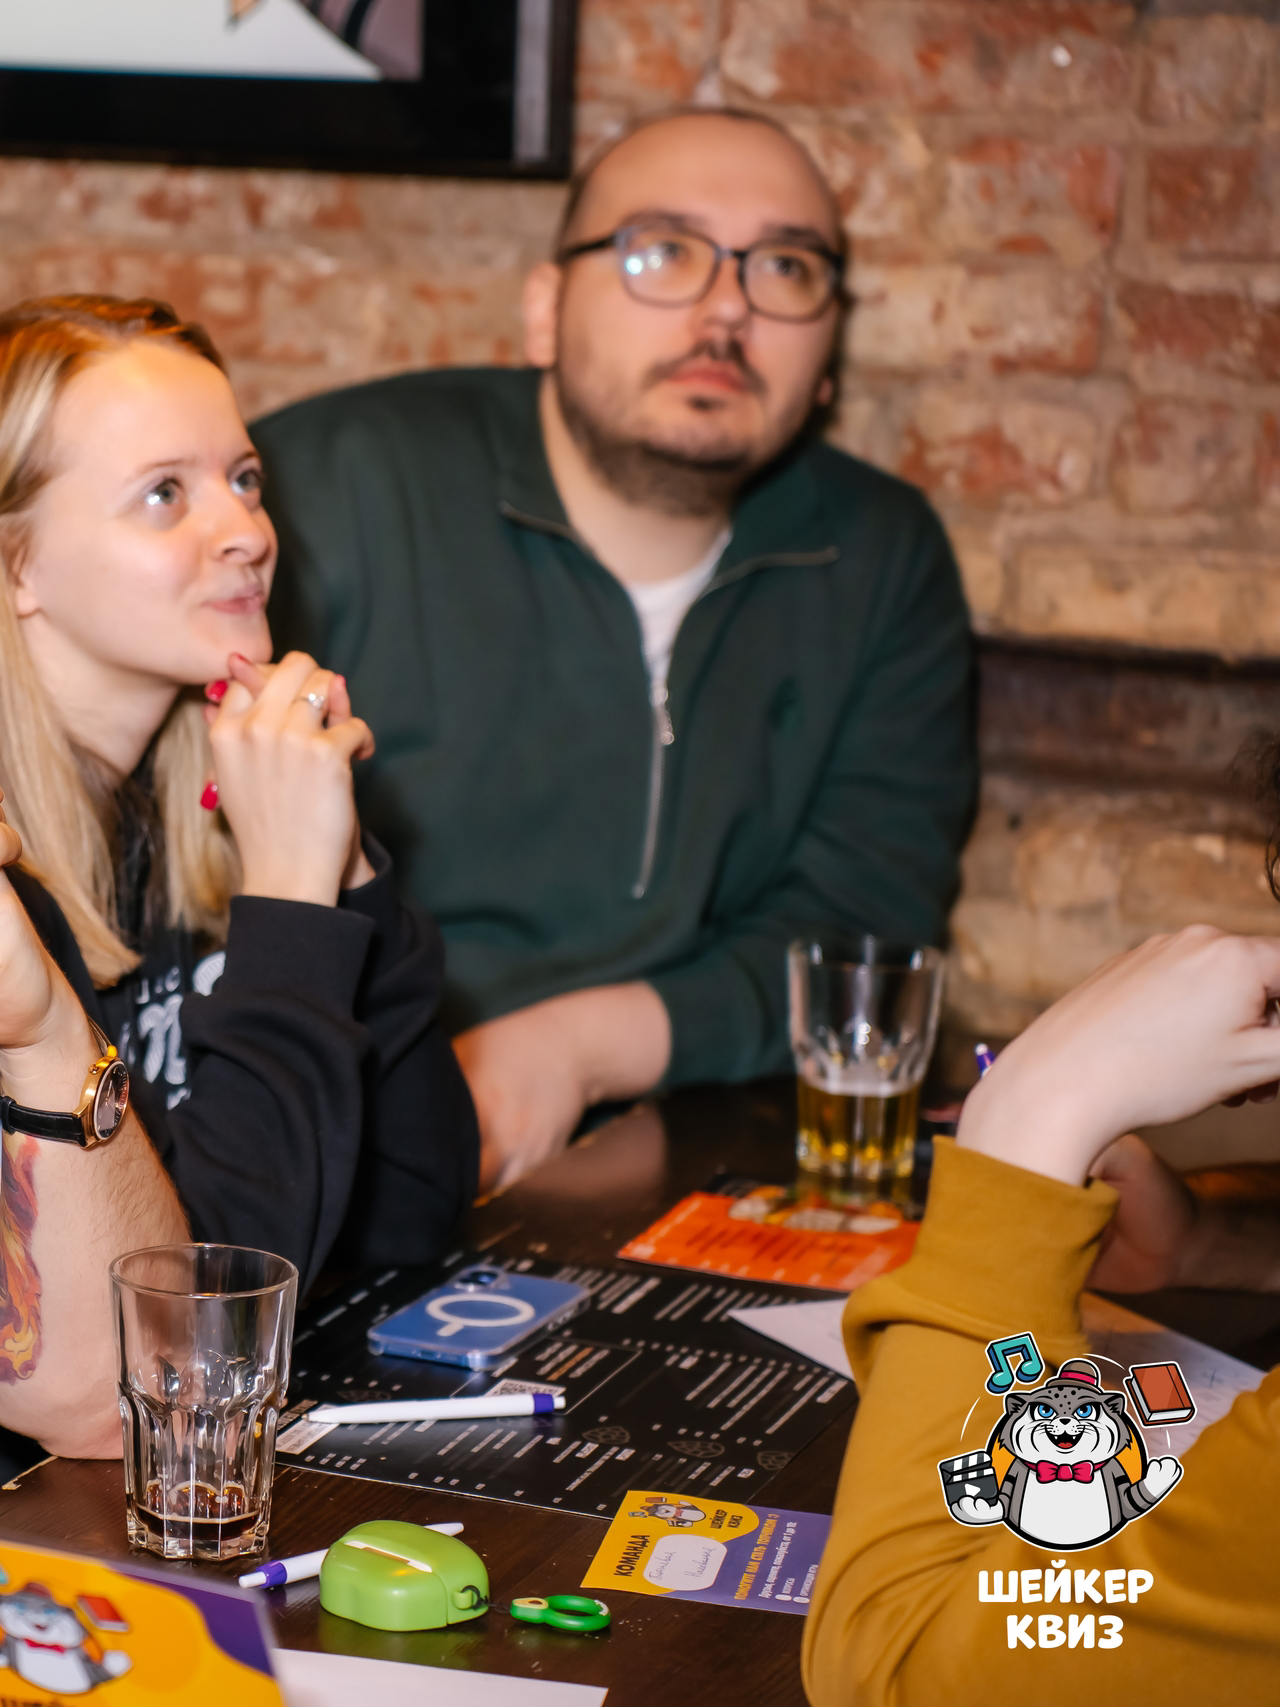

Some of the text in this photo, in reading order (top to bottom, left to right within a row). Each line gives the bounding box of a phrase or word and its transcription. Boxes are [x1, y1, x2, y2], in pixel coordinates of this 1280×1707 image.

[727, 1514, 744, 1529] КВИЗ
[613, 1534, 651, 1577] КОМАНДА
[750, 1546, 767, 1561] СТАТЬ
[745, 1561, 761, 1573] НАМ
[734, 1572, 756, 1600] ПОМОГИТЕ
